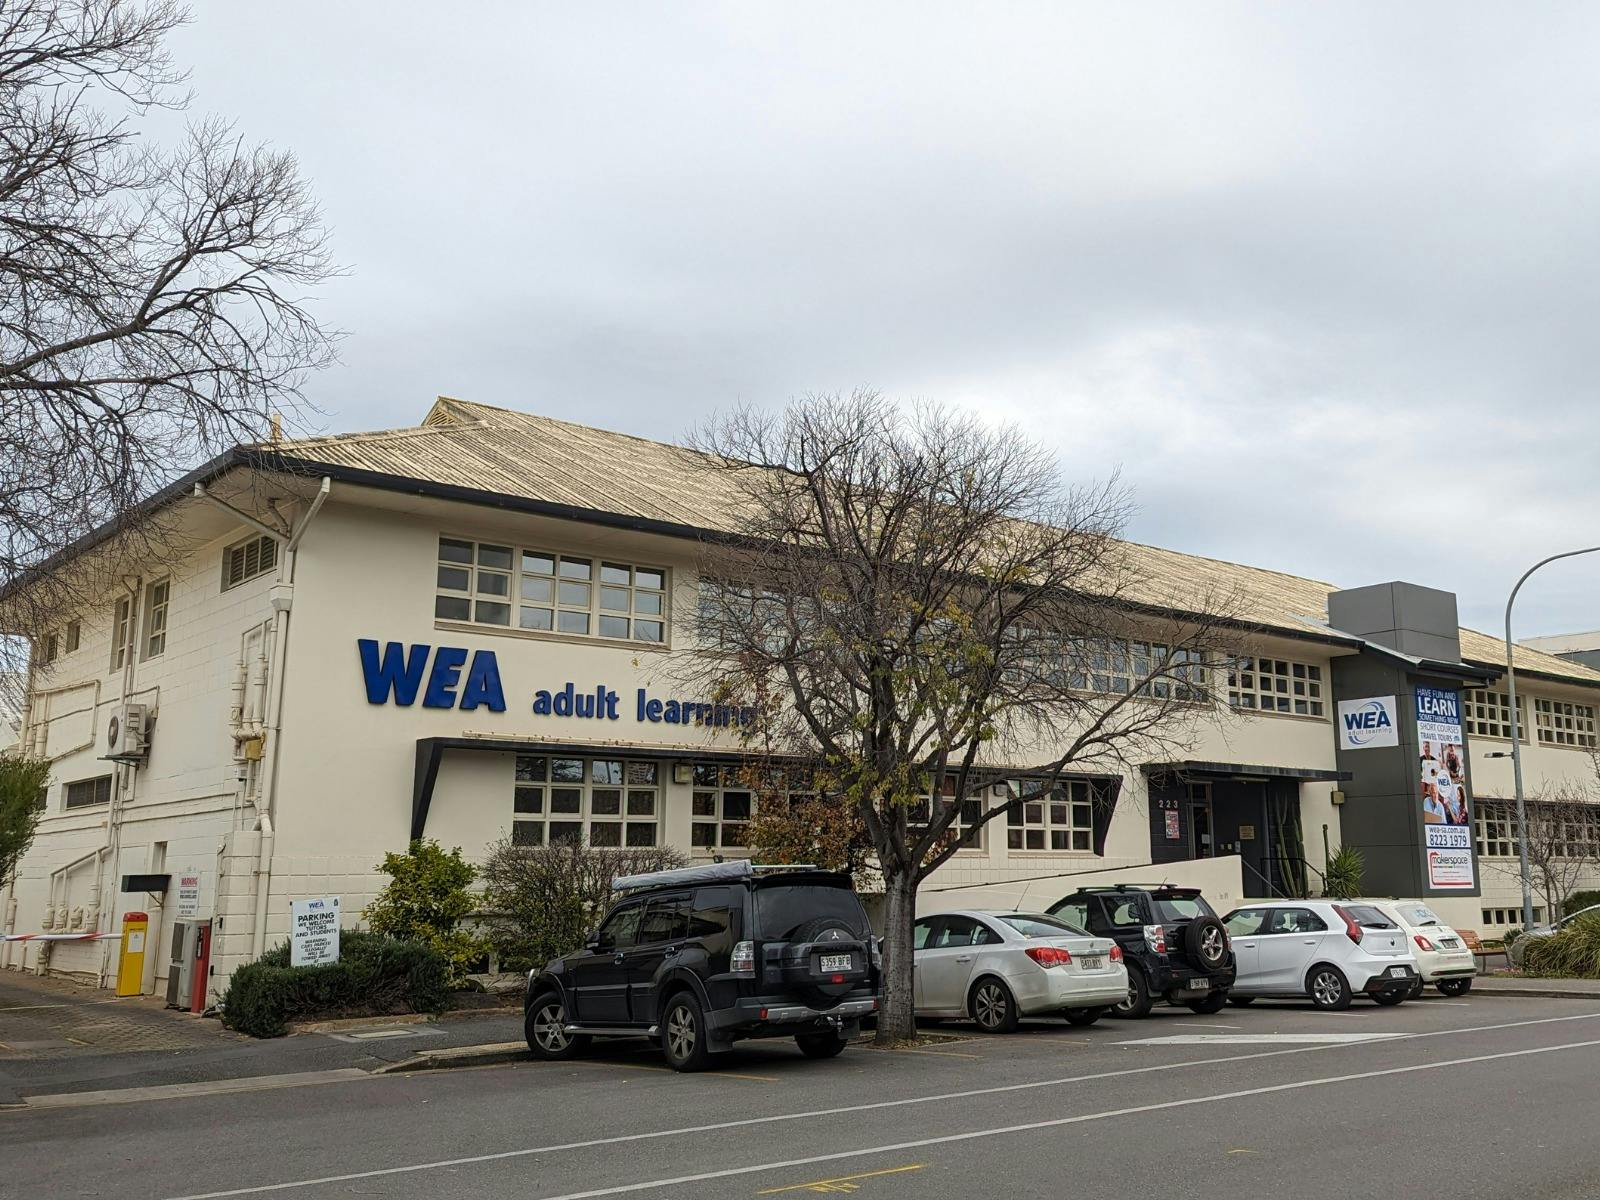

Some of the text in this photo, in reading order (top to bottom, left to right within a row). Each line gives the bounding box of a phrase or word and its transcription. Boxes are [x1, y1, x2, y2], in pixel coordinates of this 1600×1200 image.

[358, 639, 506, 712] WEA
[1417, 688, 1456, 700] HAVE FUN AND
[532, 682, 620, 720] adult
[1418, 696, 1456, 717] LEARN
[1344, 711, 1391, 730] WEA
[1419, 713, 1447, 723] SOMETHING
[1420, 723, 1459, 733] SHORT COURSES
[1420, 732, 1437, 740] TRAVEL
[1438, 778, 1450, 786] WEA
[1430, 834, 1467, 847] 8223 1979
[1432, 853, 1468, 867] makerspace
[298, 912, 334, 922] PARKING
